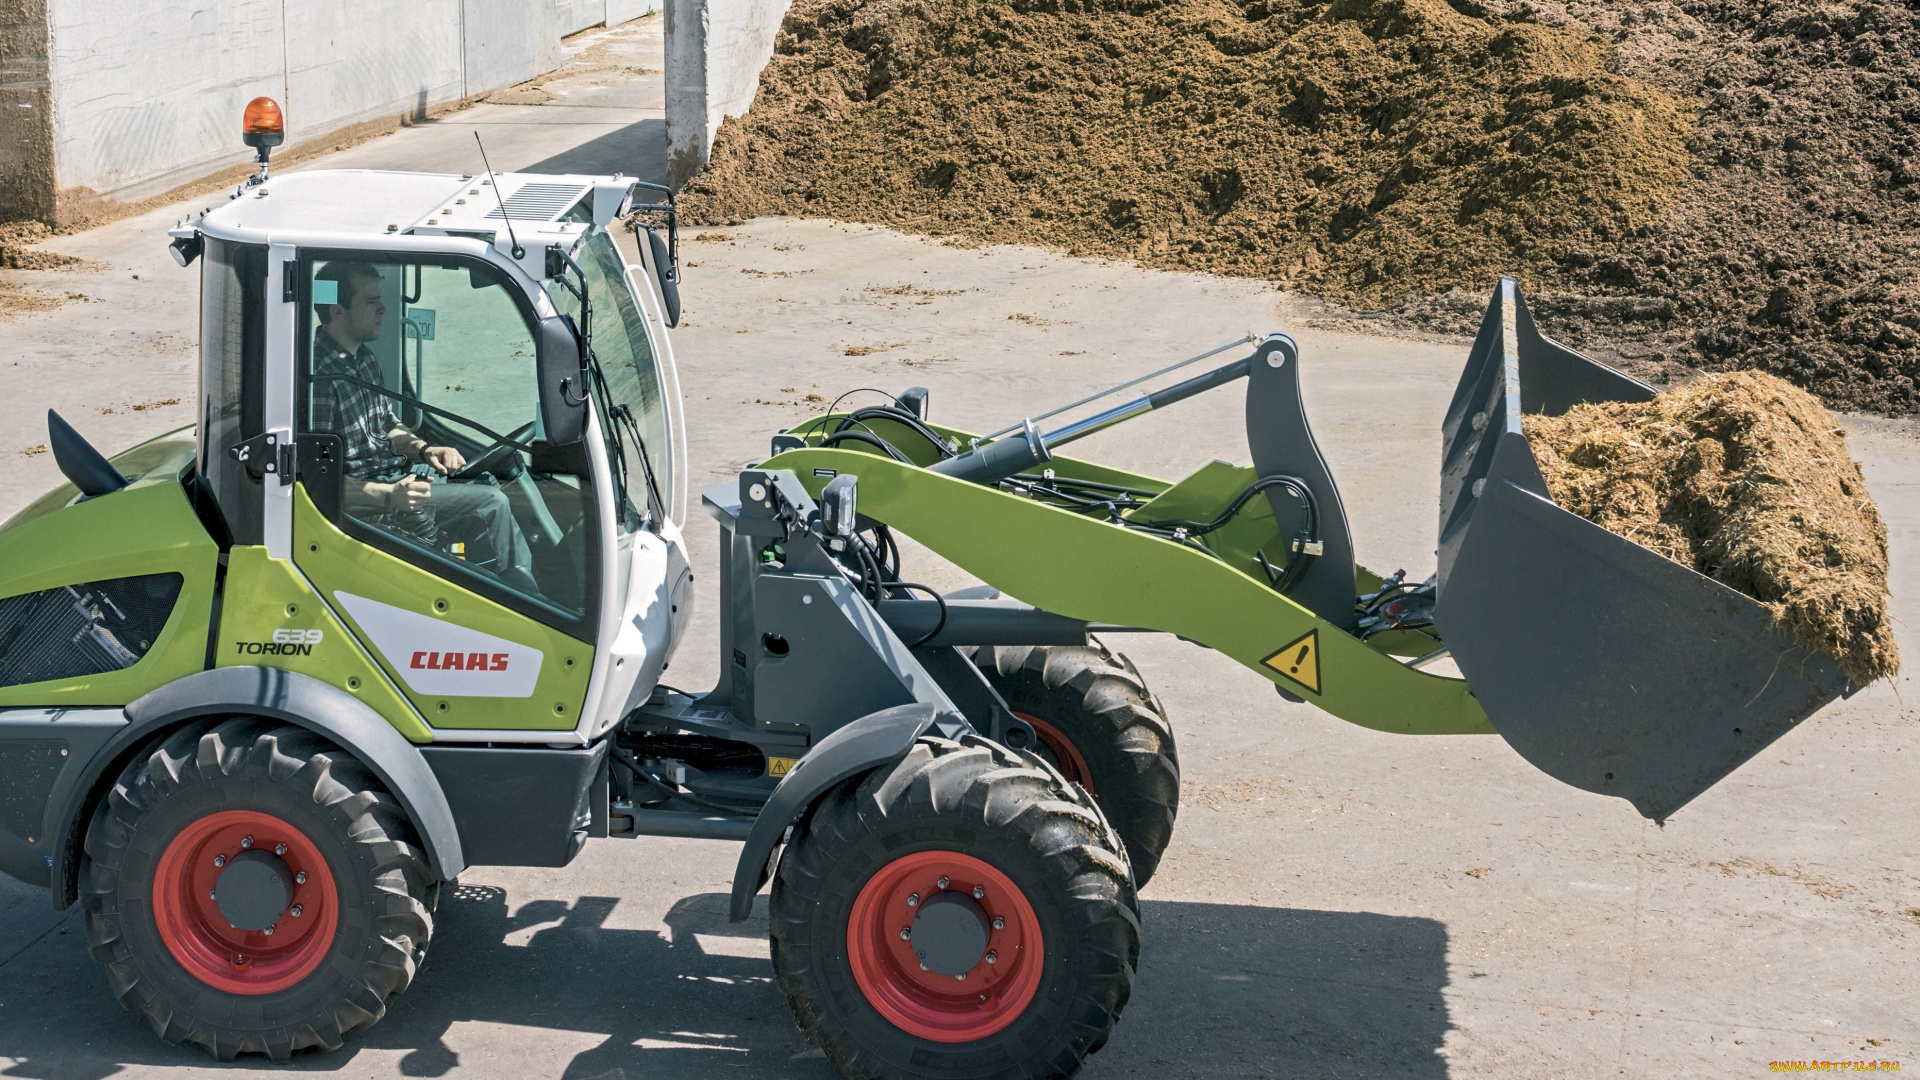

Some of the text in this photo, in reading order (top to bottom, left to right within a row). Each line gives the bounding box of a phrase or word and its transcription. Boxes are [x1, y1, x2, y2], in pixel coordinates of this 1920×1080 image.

[272, 628, 323, 644] 639
[236, 641, 313, 656] TORION
[409, 651, 509, 671] CLAAS
